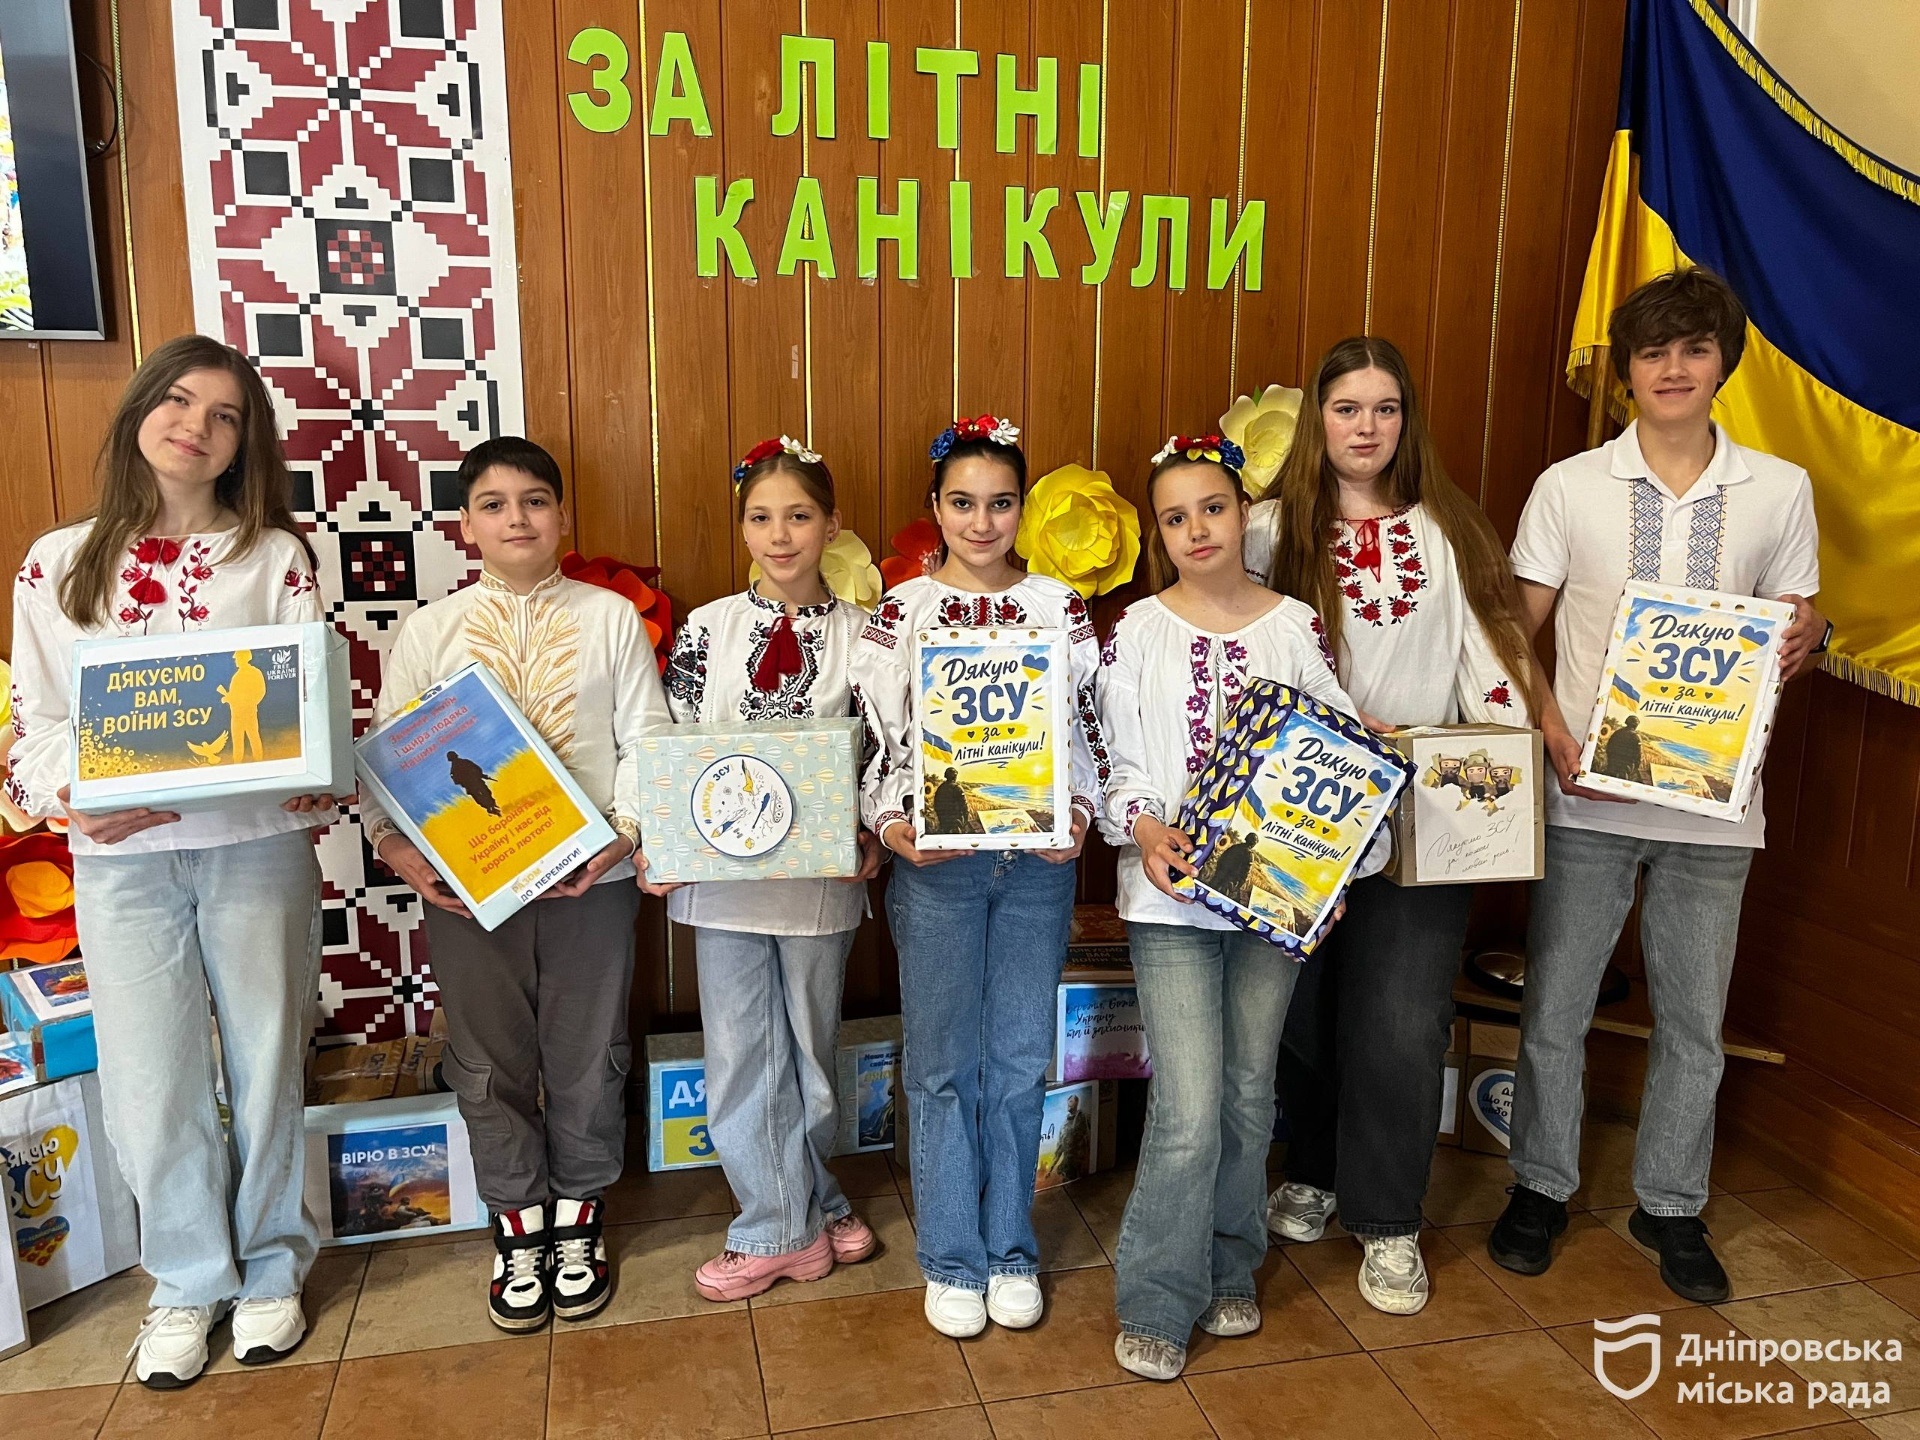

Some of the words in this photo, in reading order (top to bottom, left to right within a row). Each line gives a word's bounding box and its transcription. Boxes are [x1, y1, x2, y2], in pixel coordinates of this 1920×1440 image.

[567, 27, 713, 137] ЗА
[771, 34, 1101, 157] ЛІТНІ
[694, 176, 1266, 291] КАНІКУЛИ
[1650, 614, 1734, 646] Дякую
[107, 664, 205, 693] ДЯКУЄМО
[941, 658, 1018, 686] Дякую
[1649, 642, 1741, 685] ЗСУ
[134, 689, 182, 709] ВАМ,
[952, 681, 1029, 726] ЗСУ
[1674, 686, 1696, 700] за
[103, 711, 168, 735] ВОЇНИ
[172, 707, 212, 729] ЗСУ
[1640, 700, 1675, 714] літні
[1677, 704, 1746, 725] канікули!
[401, 731, 431, 754] щира
[431, 705, 468, 734] подяка
[982, 727, 1001, 744] за
[954, 745, 983, 760] літні
[988, 732, 1046, 759] канікули!
[1293, 737, 1367, 781] Дякую
[713, 765, 730, 782] ЗСУ
[1281, 766, 1365, 823] ЗСУ
[470, 834, 510, 864] Україну
[514, 817, 533, 833] нас
[534, 805, 552, 820] від
[1295, 815, 1315, 829] за
[468, 833, 488, 848] Що
[481, 846, 515, 875] ворога
[516, 817, 555, 850] лютого!
[1262, 821, 1292, 840] літні
[1293, 834, 1352, 861] канікули!
[511, 868, 542, 893] РАЗОМ
[520, 889, 533, 903] ДО
[535, 847, 582, 890] ПЕРЕМОГИ!
[6, 1137, 60, 1168] якую
[341, 1150, 384, 1164] ВІРЮ
[388, 1148, 398, 1160] В
[401, 1144, 436, 1159] ЗСУ!
